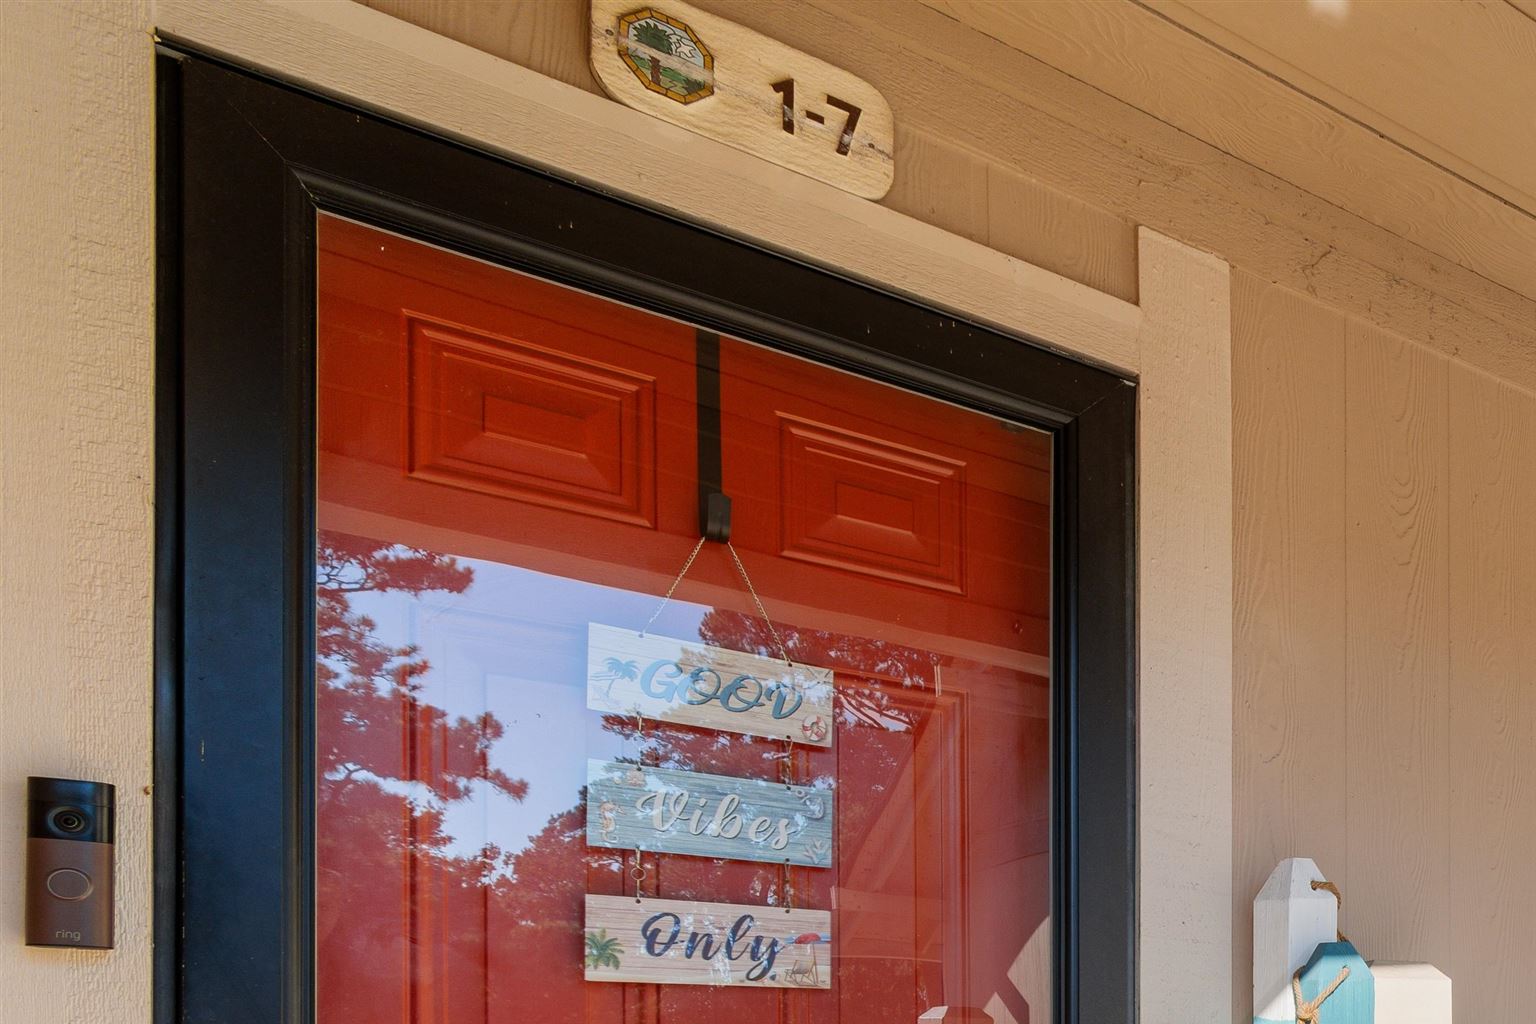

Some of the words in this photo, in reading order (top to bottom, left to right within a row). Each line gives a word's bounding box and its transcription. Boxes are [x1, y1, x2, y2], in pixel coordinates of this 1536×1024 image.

[770, 78, 862, 156] 1-7
[636, 790, 798, 850] Vibes
[56, 930, 81, 941] ring
[641, 912, 786, 982] Only
